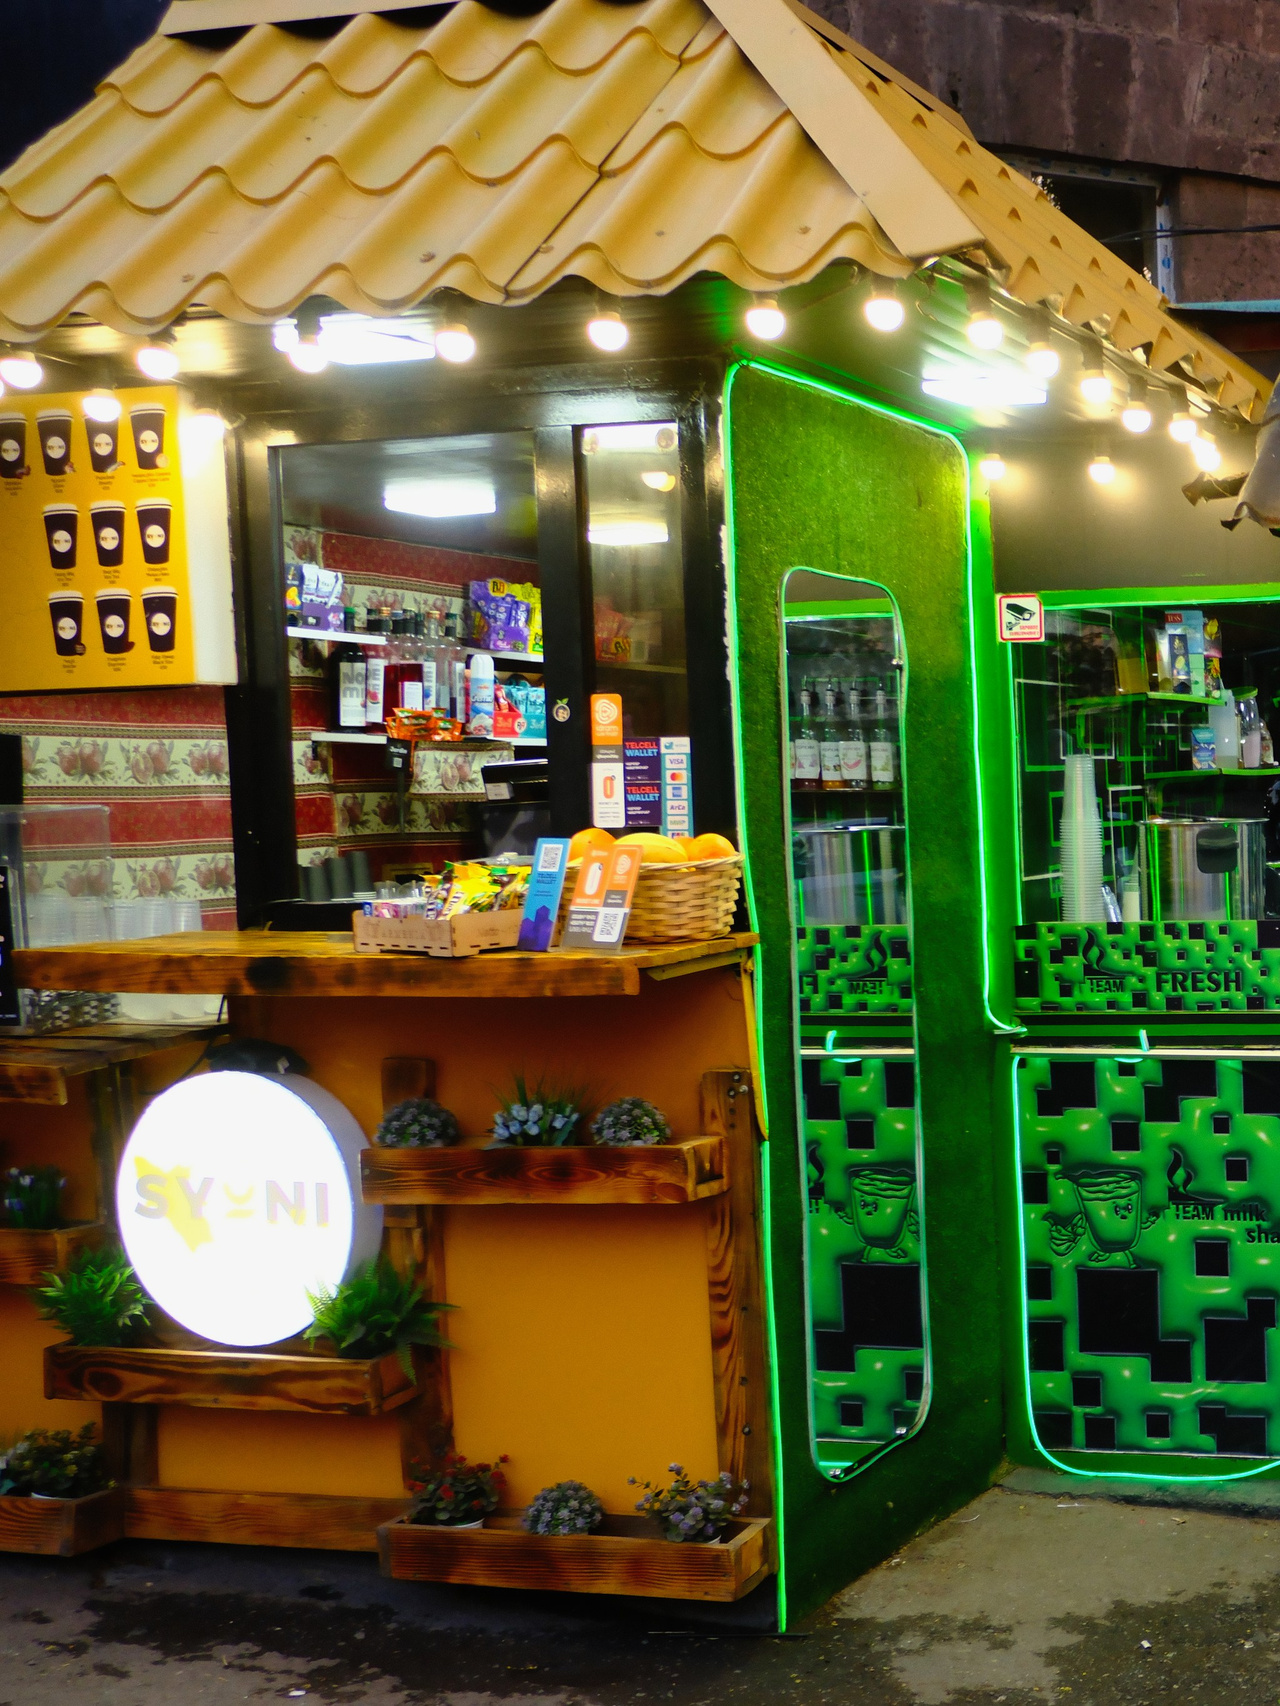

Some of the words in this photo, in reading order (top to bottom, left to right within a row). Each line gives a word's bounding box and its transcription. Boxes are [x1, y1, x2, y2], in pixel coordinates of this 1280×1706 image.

[625, 741, 658, 749] TELCELL
[625, 749, 659, 757] WALLET
[626, 786, 660, 794] TELCELL
[627, 794, 660, 802] WALLET
[1087, 977, 1125, 993] TEAM
[1155, 970, 1242, 993] FRESH
[1174, 1204, 1215, 1221] TEAM
[1223, 1202, 1267, 1222] milk
